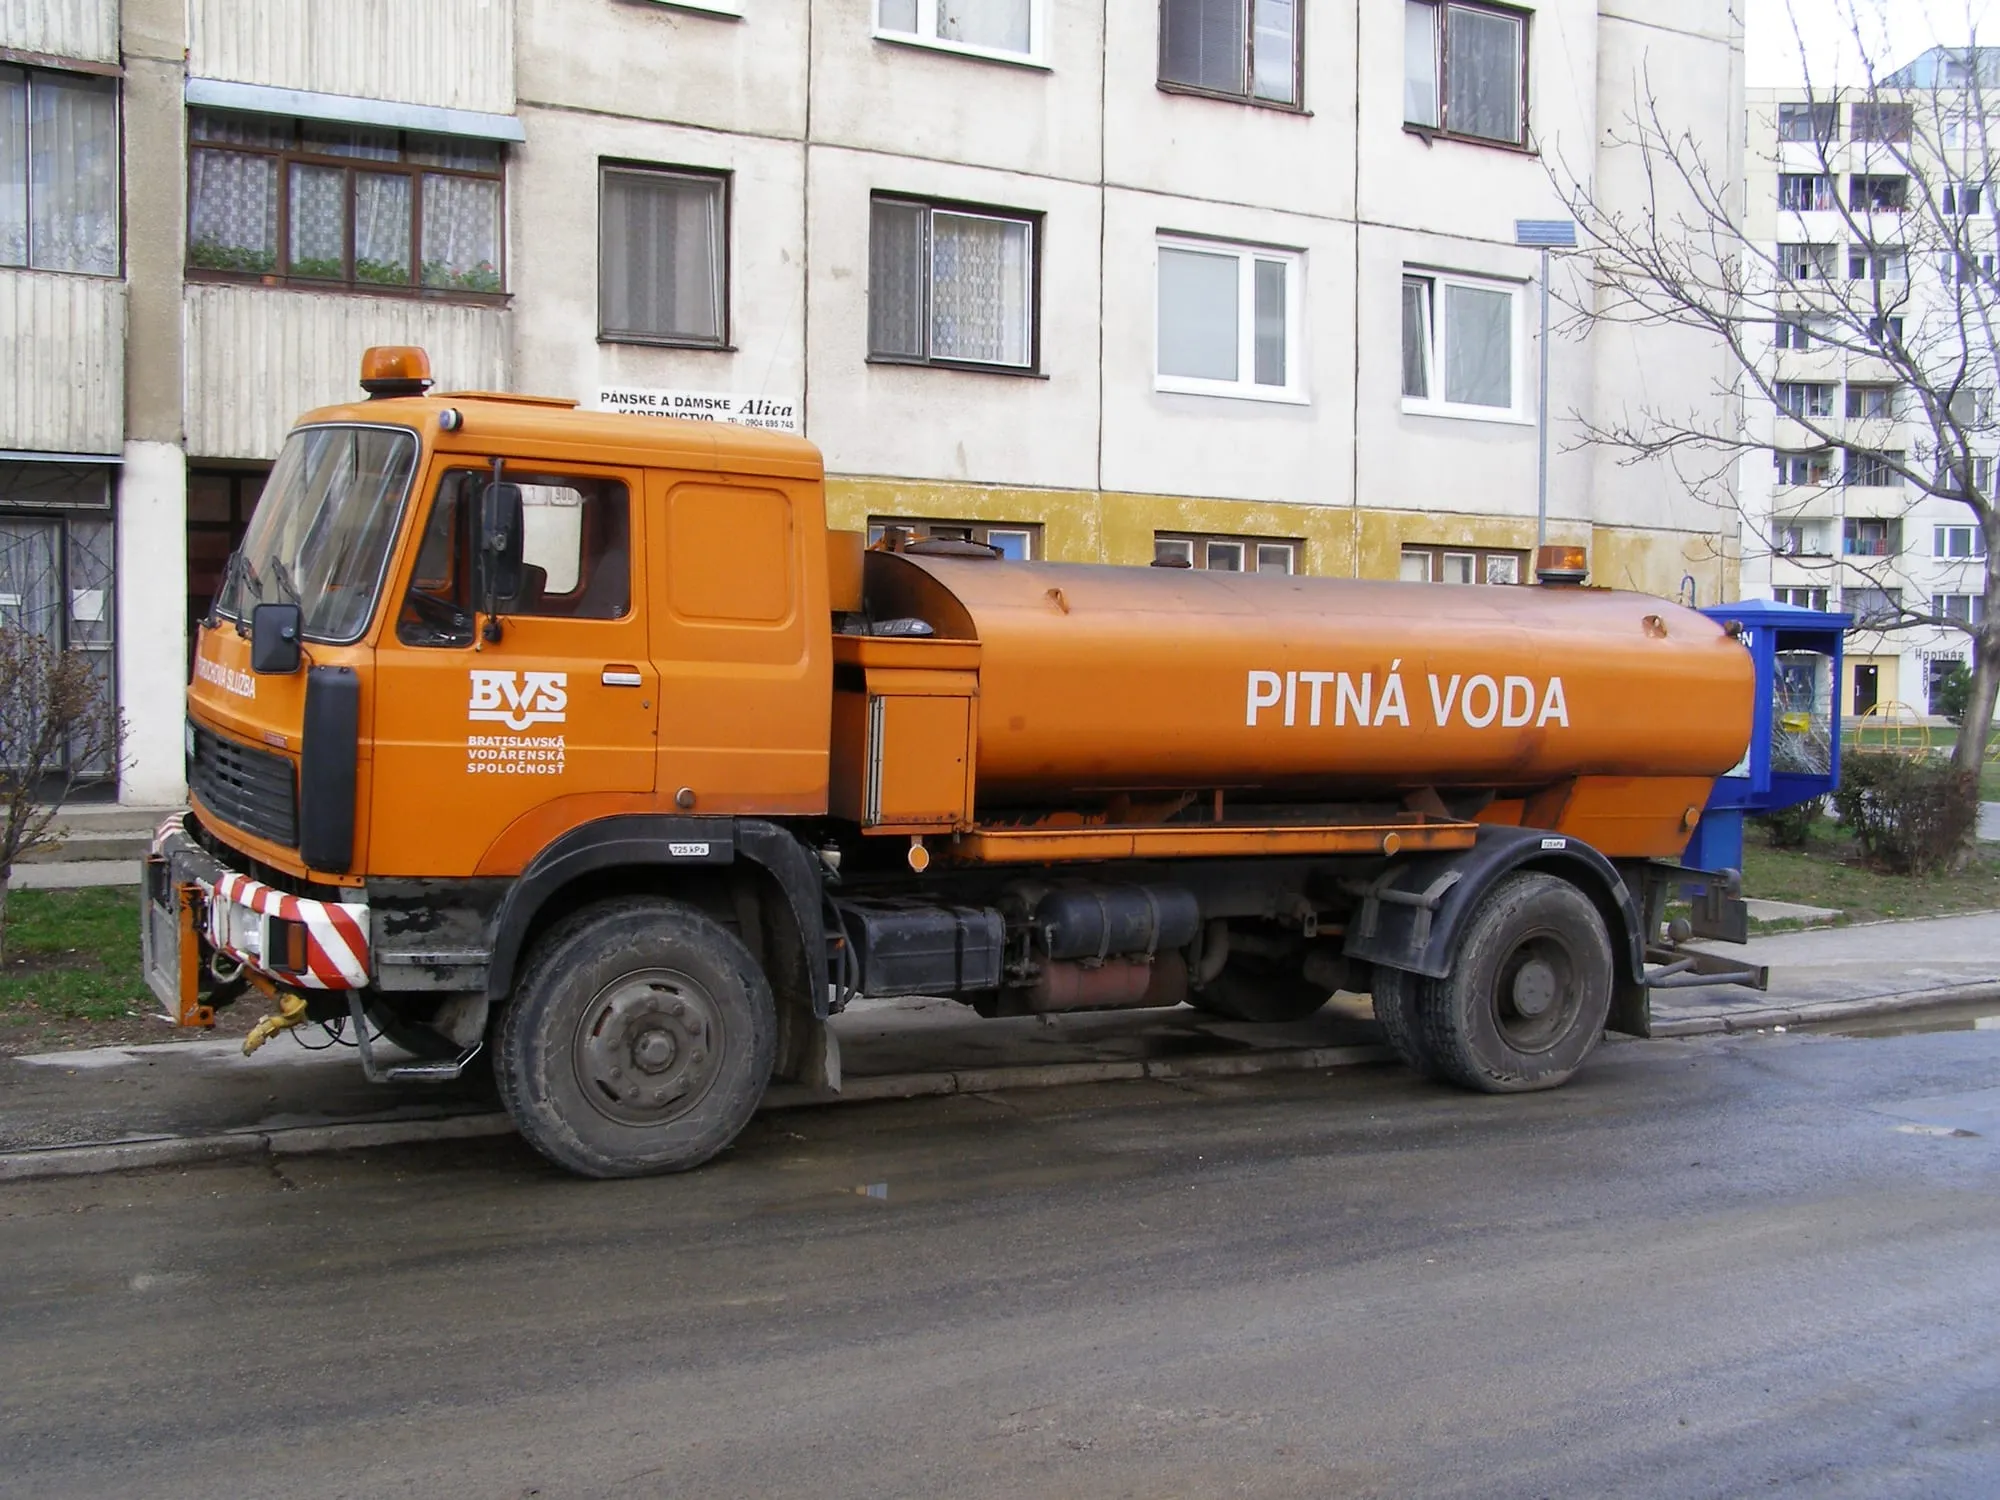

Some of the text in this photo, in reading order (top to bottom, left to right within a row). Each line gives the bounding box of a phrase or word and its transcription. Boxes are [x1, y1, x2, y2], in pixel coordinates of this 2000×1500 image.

[601, 390, 731, 410] PÁNSKE A DÁMSKE
[738, 398, 793, 416] Alica
[469, 669, 568, 712] BVS
[1246, 658, 1569, 728] PITNÁ VODA
[467, 735, 566, 748] BRATISLAVSKÁ
[468, 746, 566, 761] VODÁRENSKÁ
[467, 761, 565, 774] SPOLOČNOSŤ
